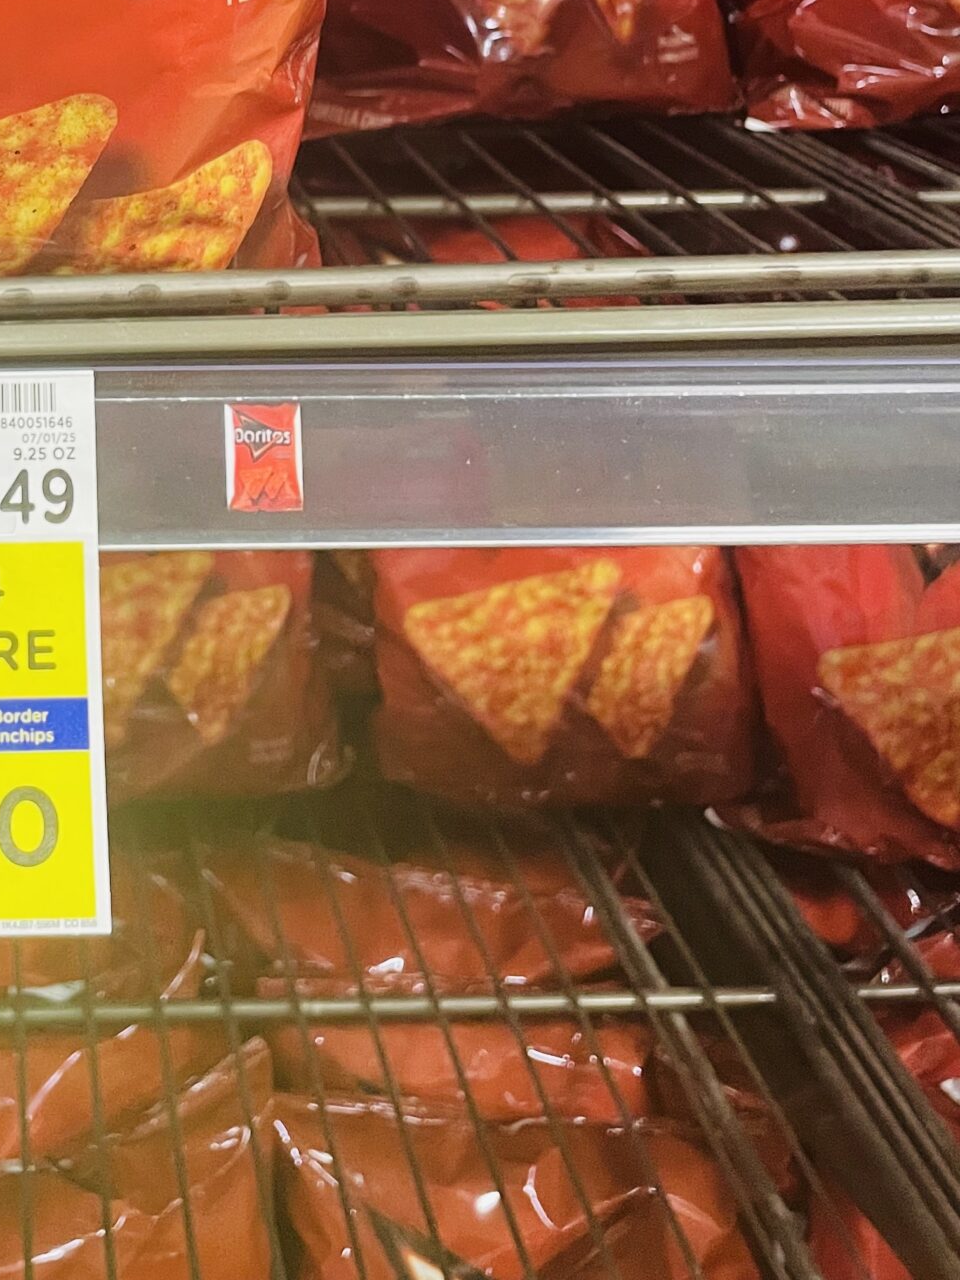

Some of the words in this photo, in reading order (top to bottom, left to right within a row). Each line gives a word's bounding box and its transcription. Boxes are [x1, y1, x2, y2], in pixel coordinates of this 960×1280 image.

[22, 432, 76, 445] 07/01/25
[235, 427, 292, 445] Doritos
[13, 448, 47, 461] 9.25
[53, 447, 77, 461] OZ
